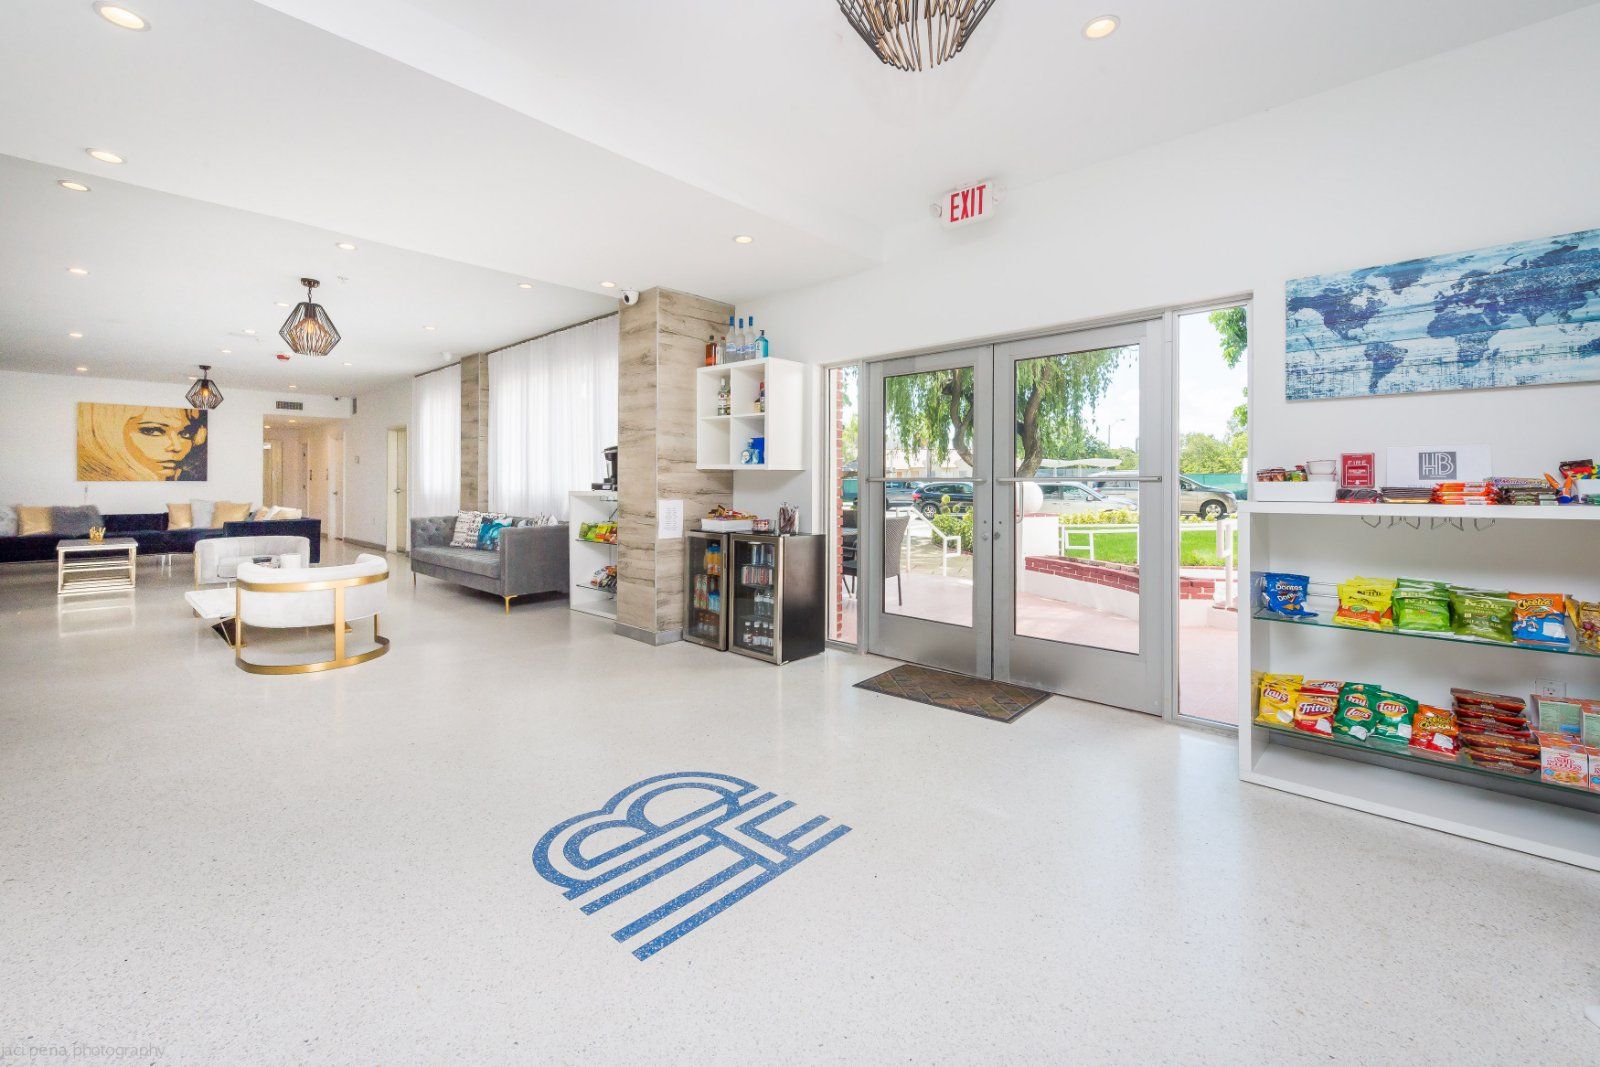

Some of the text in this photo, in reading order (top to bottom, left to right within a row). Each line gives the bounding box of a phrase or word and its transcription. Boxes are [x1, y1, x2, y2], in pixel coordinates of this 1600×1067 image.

[950, 184, 987, 223] EXIT
[1422, 452, 1455, 476] HB
[1517, 597, 1553, 611] Cheetos
[1299, 702, 1331, 714] Fritos
